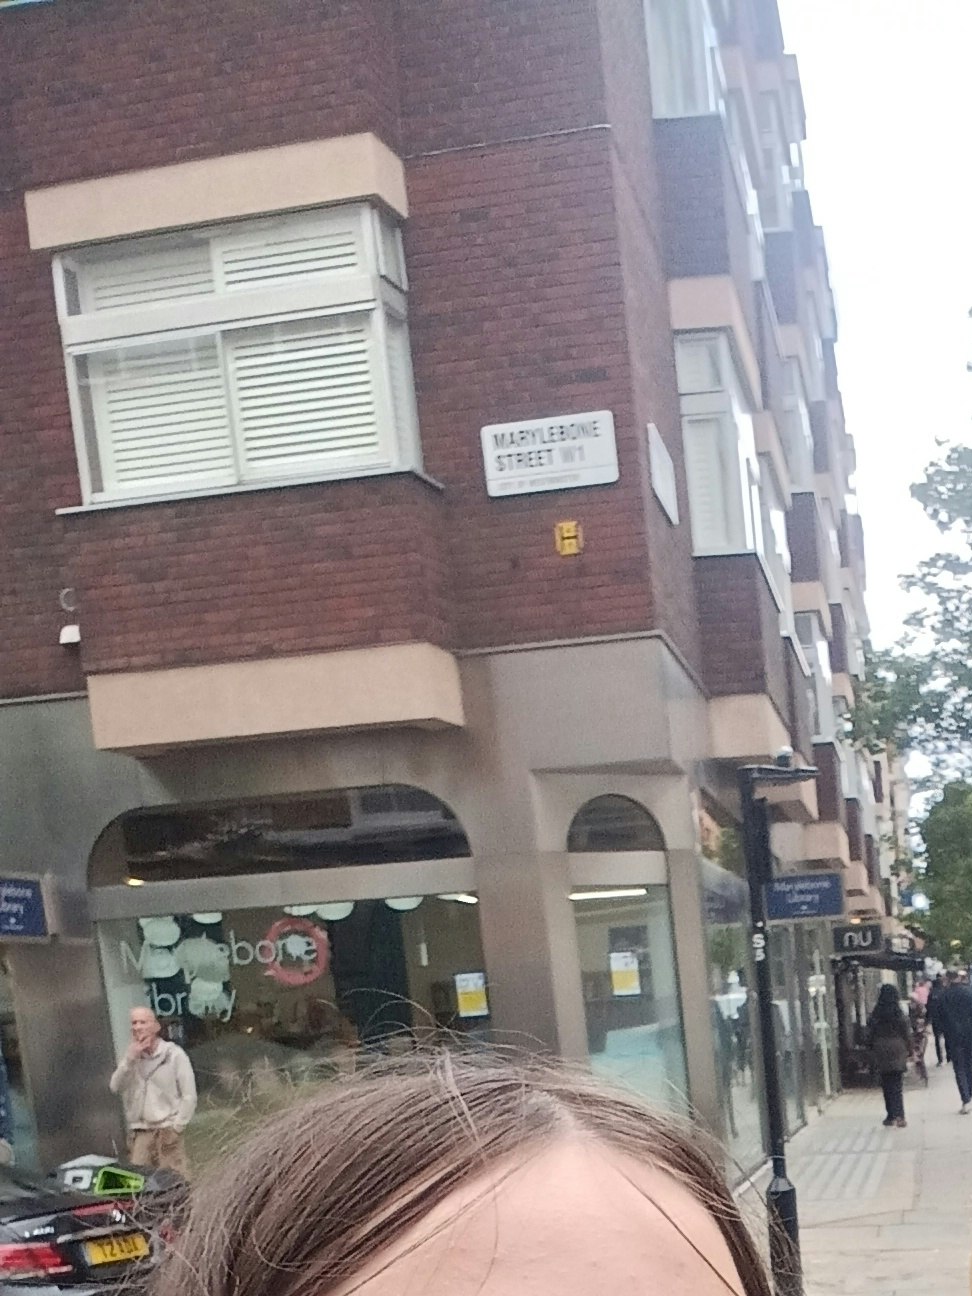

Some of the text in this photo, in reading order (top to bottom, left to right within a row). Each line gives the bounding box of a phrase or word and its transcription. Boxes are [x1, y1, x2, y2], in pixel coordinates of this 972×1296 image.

[494, 421, 601, 448] MARYLEBONE
[497, 448, 554, 471] STREET
[120, 929, 318, 985] Mebone
